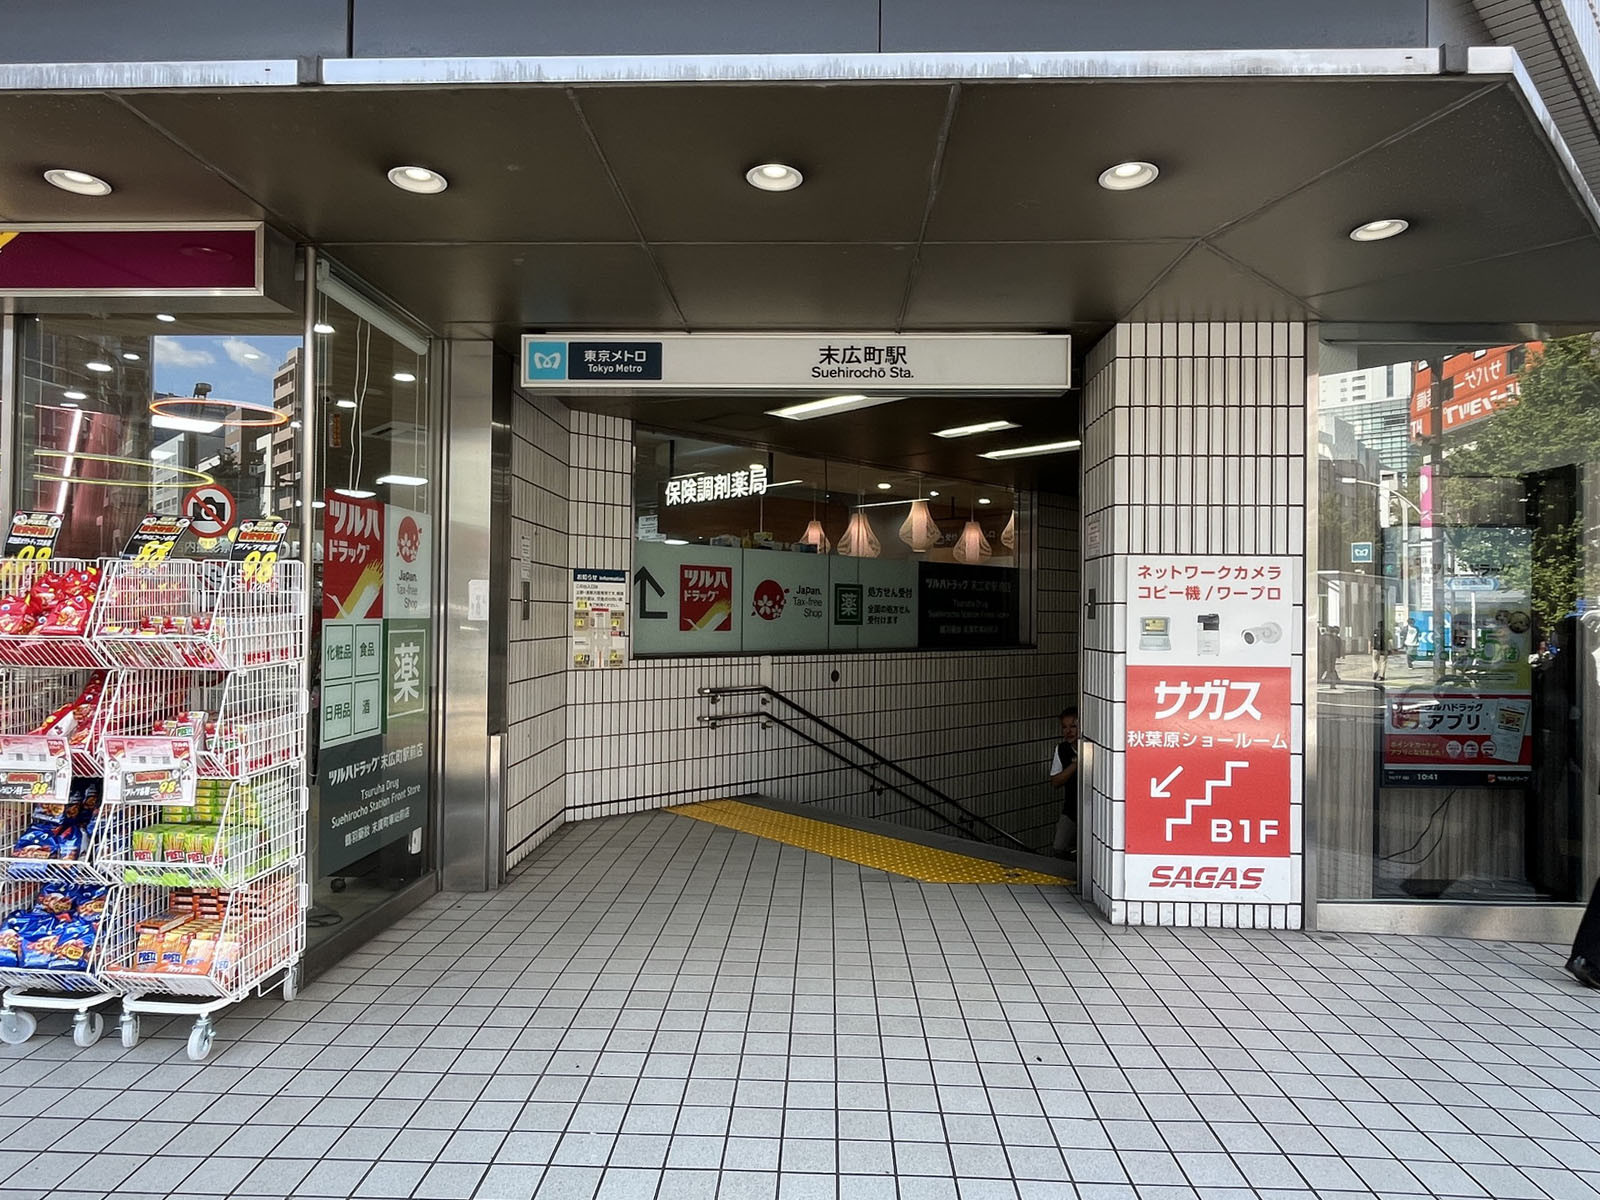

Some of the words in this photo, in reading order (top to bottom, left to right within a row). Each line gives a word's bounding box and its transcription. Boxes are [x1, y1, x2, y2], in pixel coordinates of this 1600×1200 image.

[583, 350, 647, 362] 東京メトロ
[818, 345, 908, 365] 末広町駅
[587, 363, 614, 374] Tokyo
[615, 363, 643, 373] Metro
[889, 366, 914, 378] Sta.
[664, 467, 768, 507] 保険調剤薬局
[329, 499, 381, 541] ツルハ
[328, 539, 371, 564] ドラッグ
[684, 570, 728, 589] ツルハ
[1137, 565, 1282, 580] ネットワークカメラ
[684, 590, 719, 602] ドラッグ
[867, 586, 913, 599] 処方せん受付
[803, 608, 823, 618] Shop
[841, 593, 857, 616] 薬
[327, 644, 352, 661] 化粧品
[360, 642, 374, 657] 食品
[393, 641, 420, 703] 薬
[1154, 679, 1262, 721] サガス
[325, 702, 351, 721] 日用品
[1427, 714, 1480, 730] アプリ
[1127, 730, 1288, 749] 秋葉原ショールーム
[328, 756, 379, 786] ツルハドラッグ
[32, 783, 48, 794] 88
[160, 781, 176, 793] 98
[361, 784, 385, 800] Tsuruha
[386, 778, 400, 790] Drug
[331, 806, 369, 829] Suehirocho
[369, 797, 390, 812] Station
[391, 789, 406, 803] Front
[407, 784, 421, 796] Store
[1210, 818, 1279, 844] B1F
[1149, 865, 1265, 889] SAGAS
